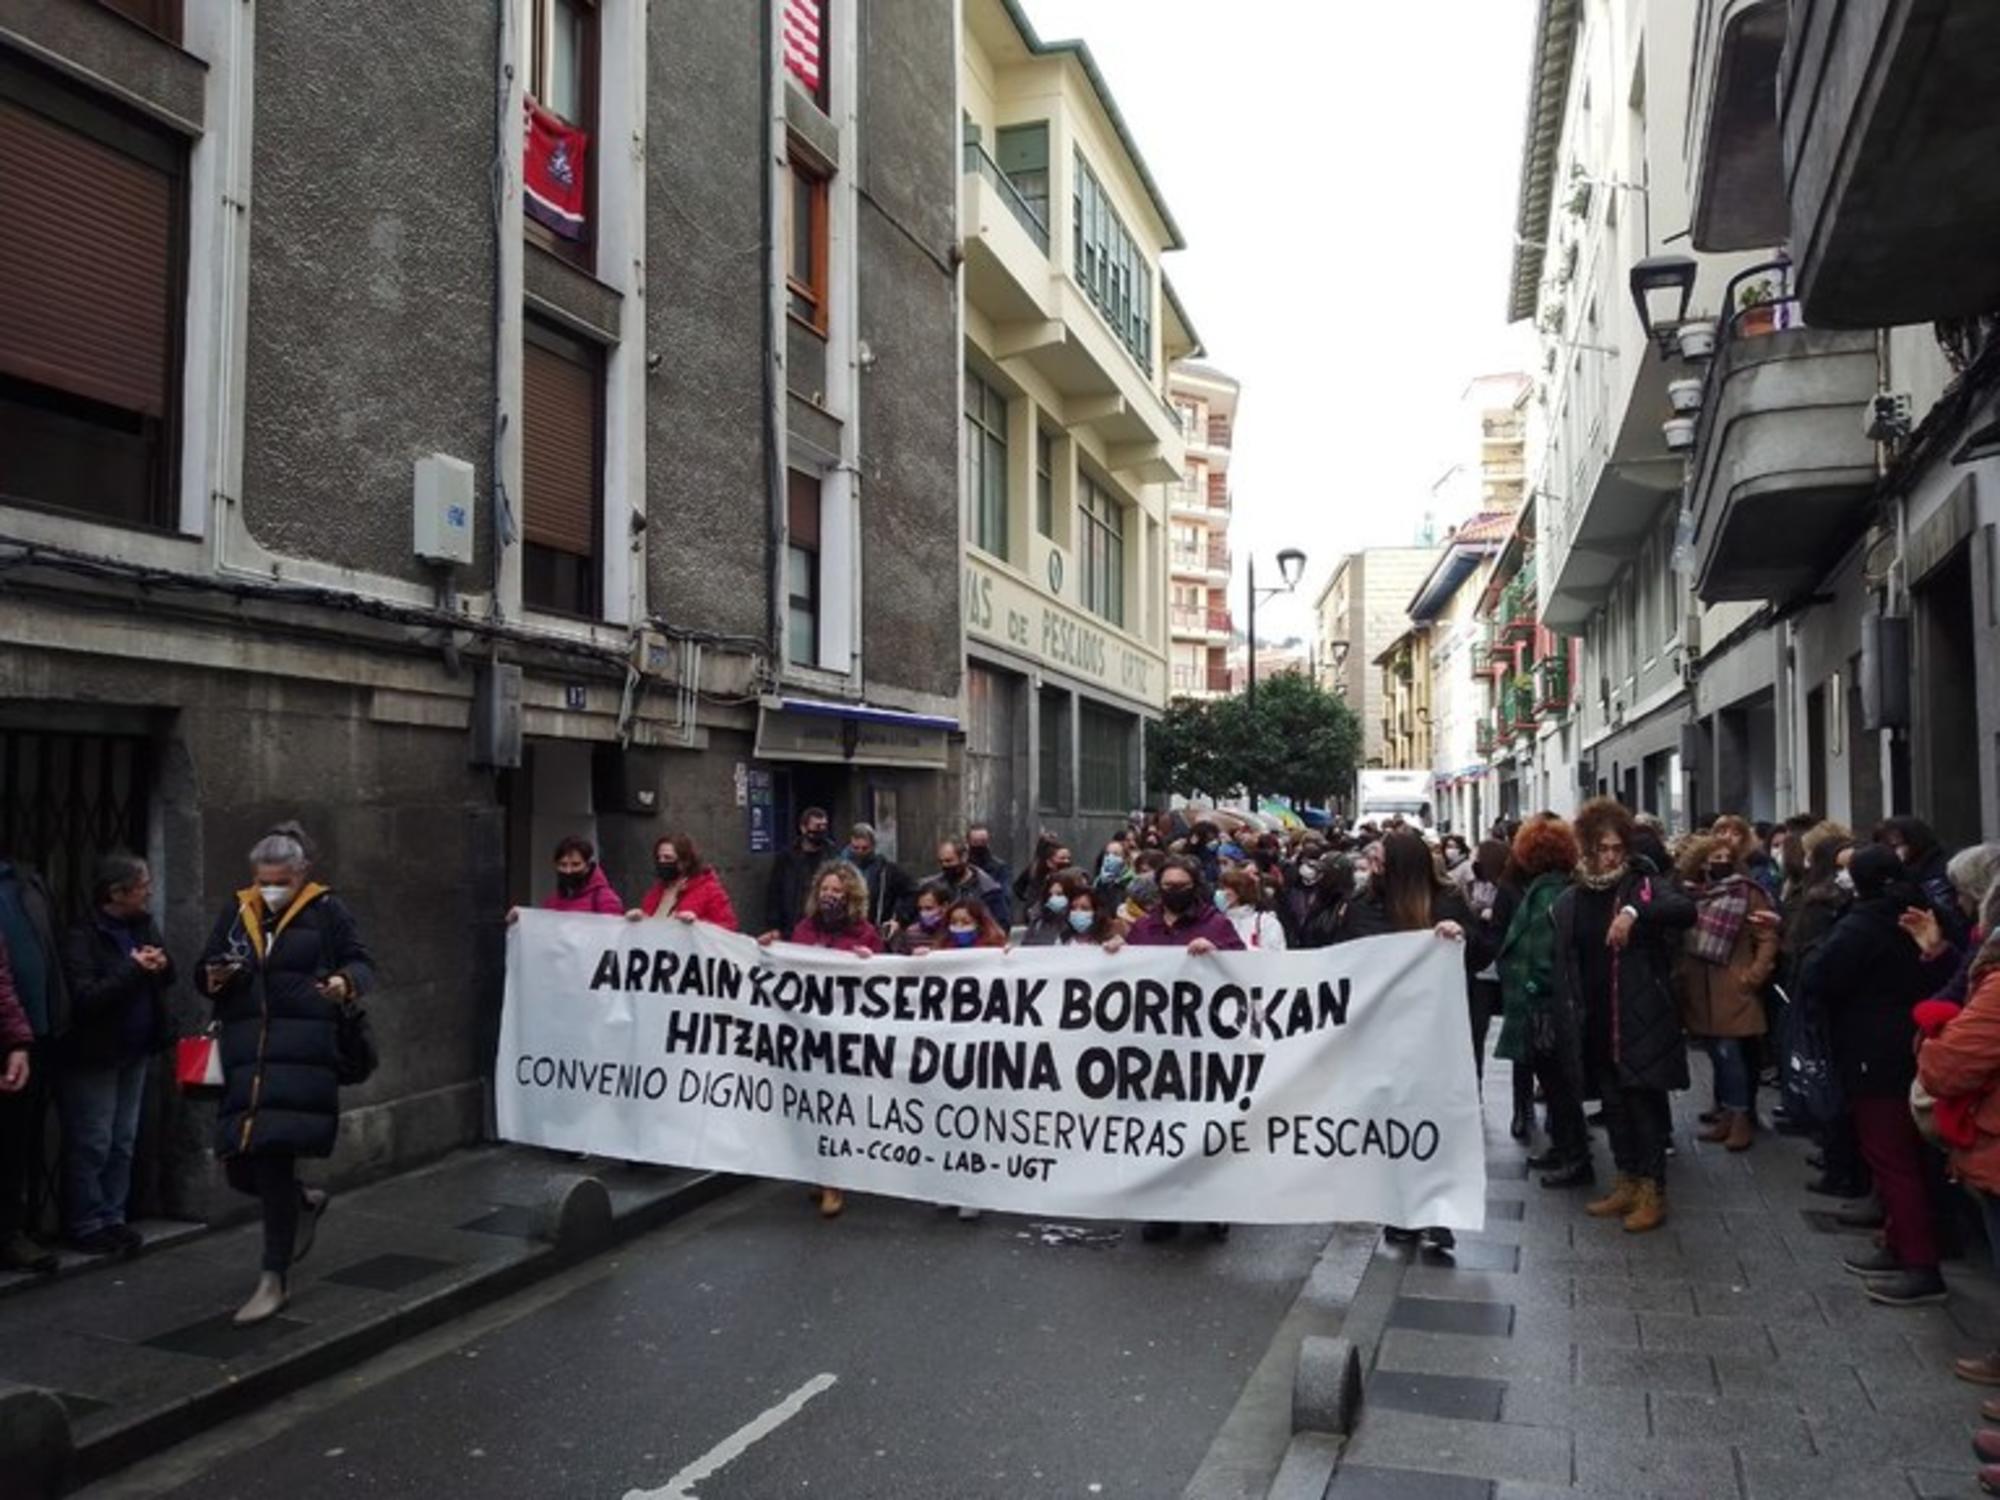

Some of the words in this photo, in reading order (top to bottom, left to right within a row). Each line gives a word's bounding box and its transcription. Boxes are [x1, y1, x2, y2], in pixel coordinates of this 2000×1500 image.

[1007, 610, 1028, 646] DE
[590, 948, 740, 996] ARRAIN
[748, 967, 1047, 1027] KONTSERBAK
[1059, 978, 1351, 1040] BORROKAN
[517, 1055, 667, 1099] CONVENIO
[679, 1068, 772, 1113] DIGNO
[783, 1084, 854, 1127] PARA
[867, 1096, 925, 1134] LAS
[935, 1105, 1186, 1157] CONSERVERAS
[1203, 1121, 1250, 1156] DE
[1267, 1117, 1439, 1160] PESCADO
[665, 1009, 895, 1078] HITZARMEN
[909, 1037, 1061, 1091] DUINA
[1076, 1047, 1265, 1110] ORAIN!
